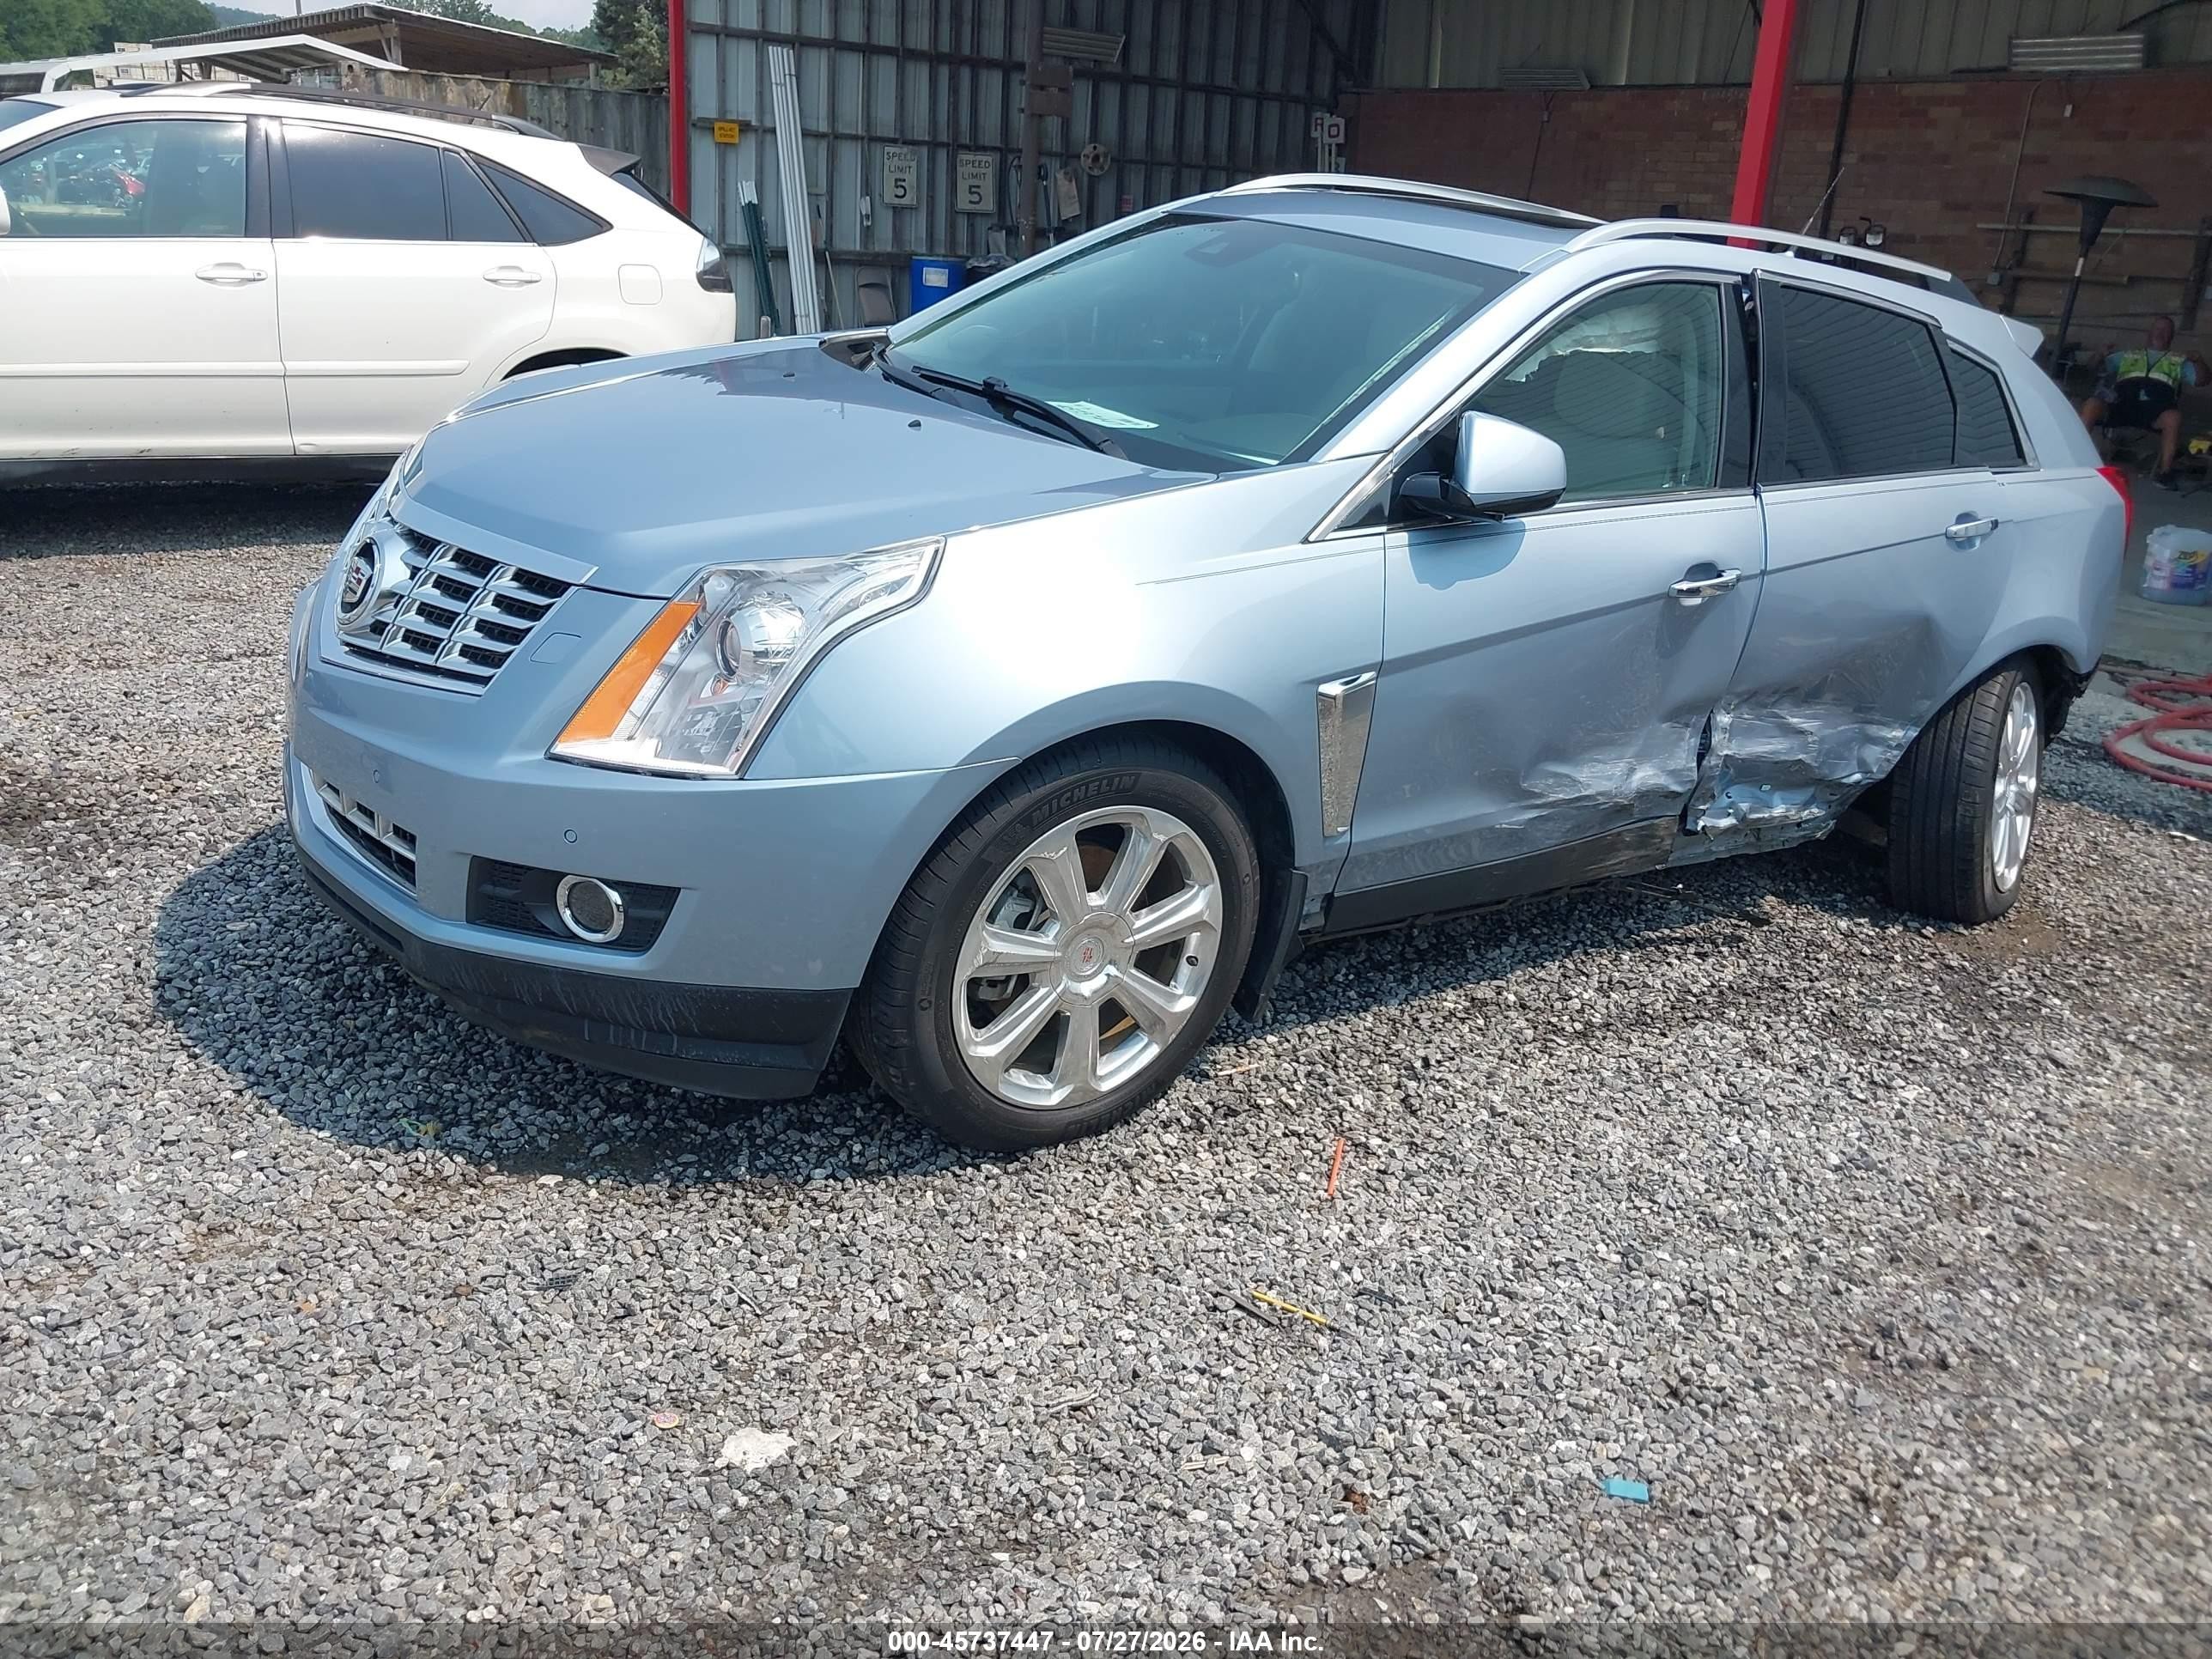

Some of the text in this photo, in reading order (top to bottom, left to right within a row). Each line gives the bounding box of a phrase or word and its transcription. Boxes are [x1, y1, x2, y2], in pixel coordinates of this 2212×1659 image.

[886, 151, 915, 161] SPEED
[959, 159, 991, 169] SPEED
[889, 165, 913, 174] LIMIT
[962, 171, 987, 181] LIMIT
[894, 178, 907, 198] 5
[968, 185, 983, 205] 5
[1032, 775, 1135, 826] MICHELIN
